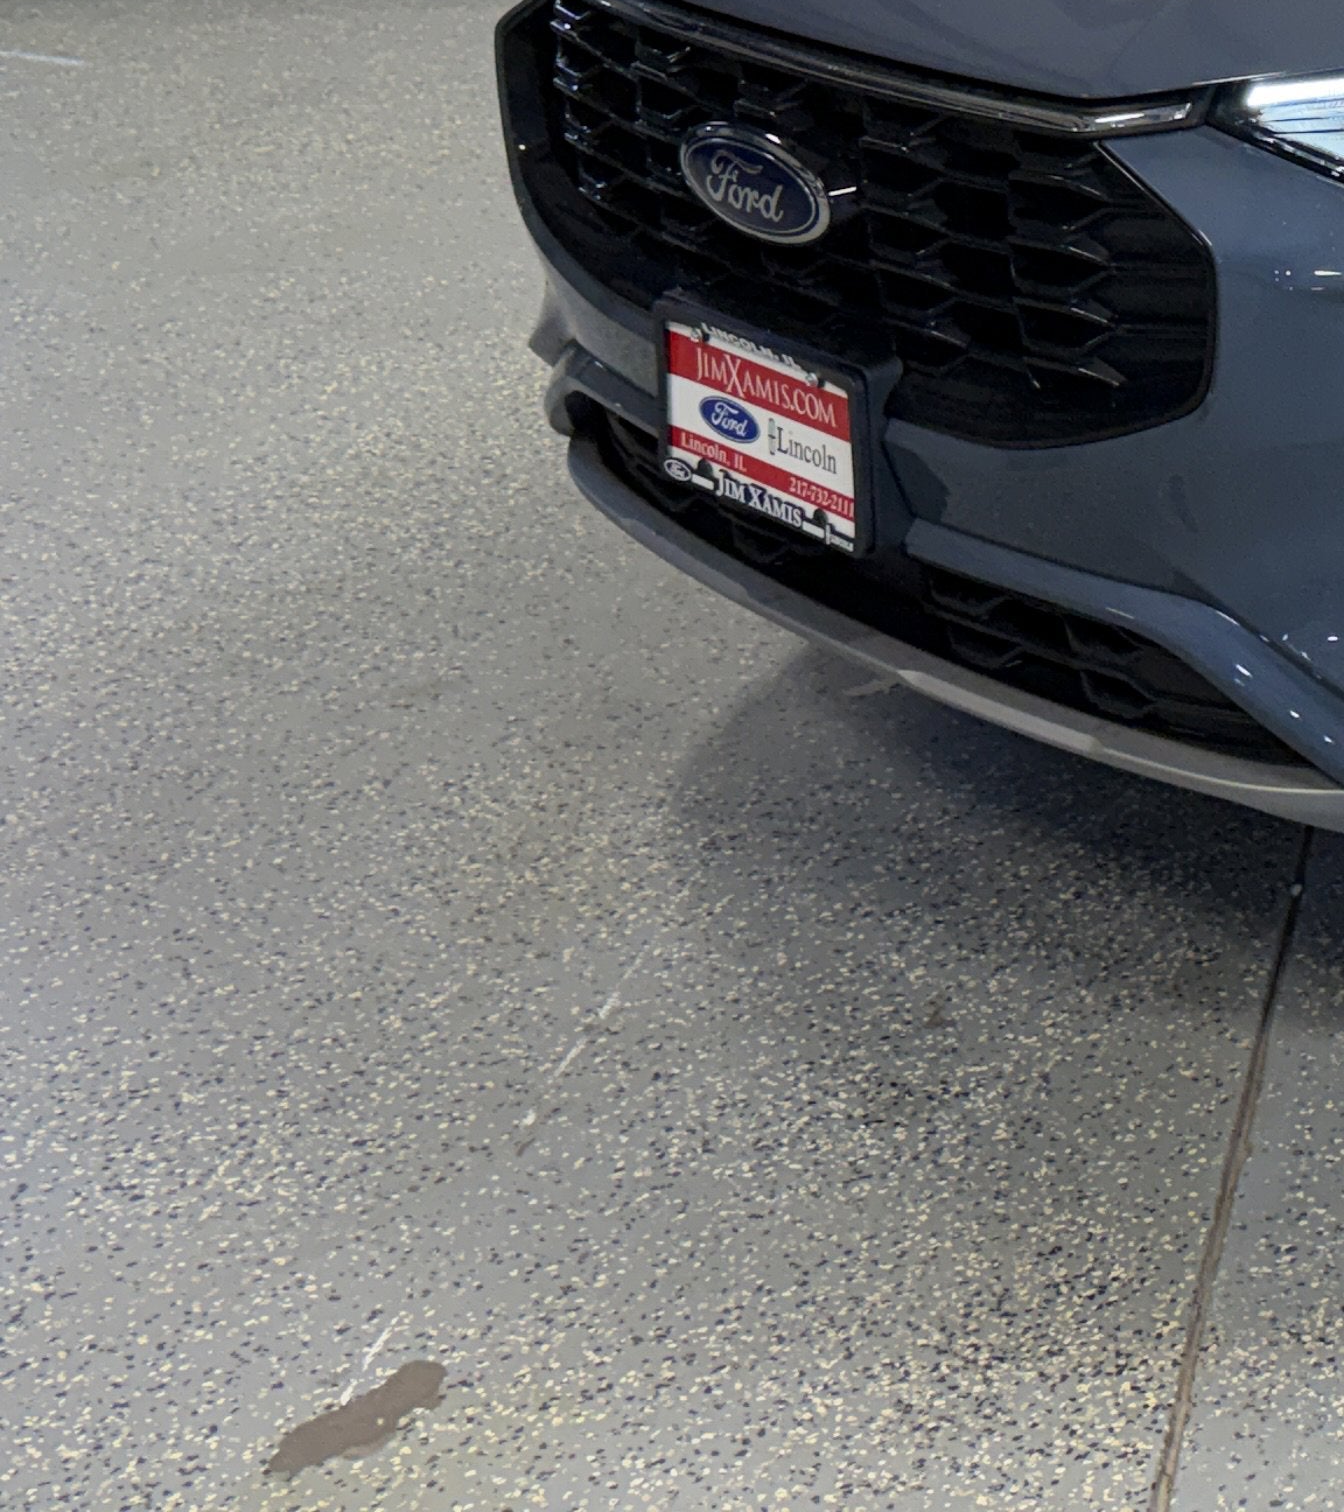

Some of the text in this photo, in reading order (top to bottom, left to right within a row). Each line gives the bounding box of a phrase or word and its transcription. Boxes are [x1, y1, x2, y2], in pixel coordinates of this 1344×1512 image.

[705, 148, 786, 224] Ford
[710, 401, 750, 438] Ford
[776, 426, 838, 475] Lincoln
[715, 471, 802, 528] JIM XAMIS
[788, 476, 855, 519] 217-732-2111
